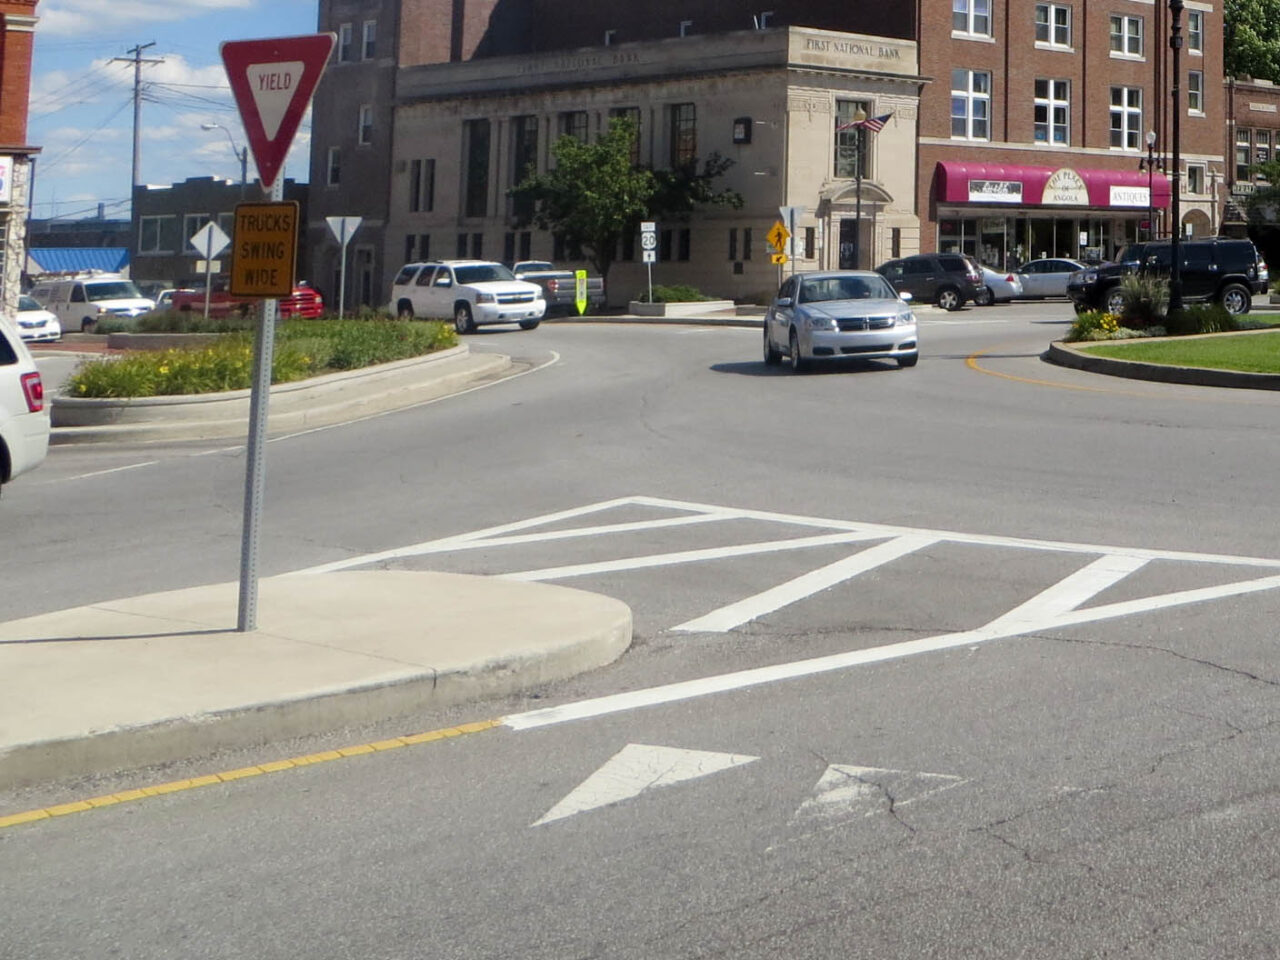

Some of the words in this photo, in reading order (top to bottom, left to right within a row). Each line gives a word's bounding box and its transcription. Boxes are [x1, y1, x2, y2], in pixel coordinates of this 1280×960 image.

[807, 39, 830, 52] FIRST
[834, 41, 874, 57] NATIONAL
[878, 47, 901, 59] BANK
[258, 72, 292, 91] YIELD
[1053, 194, 1079, 202] ANGOLA
[1112, 191, 1149, 203] ANTIQUES
[240, 214, 291, 232] TRUCKS
[643, 235, 655, 246] 20
[241, 241, 285, 260] SWING
[244, 268, 278, 287] WIDE
